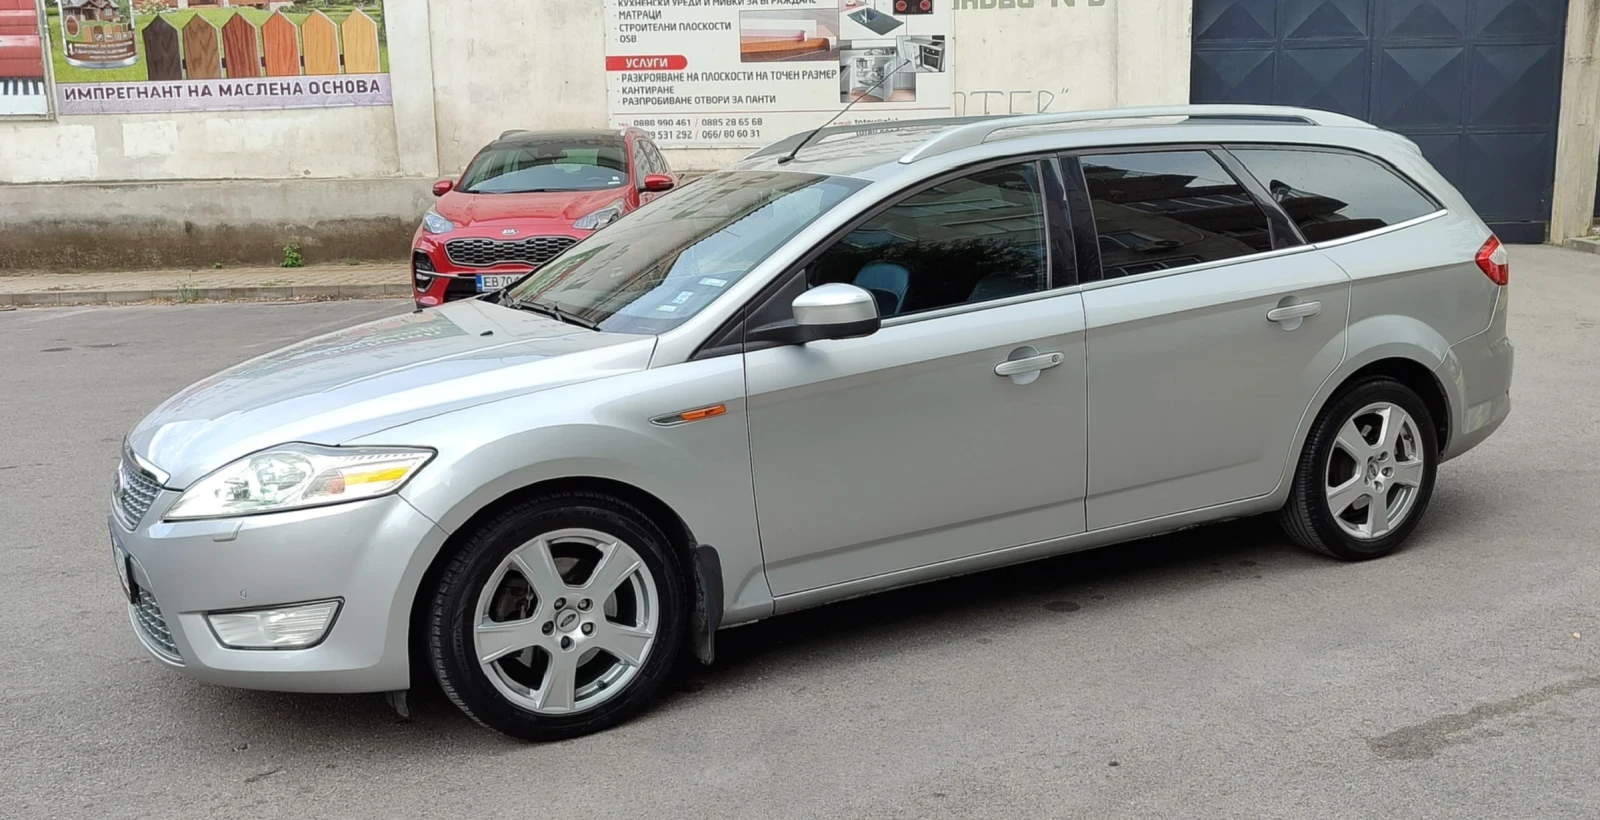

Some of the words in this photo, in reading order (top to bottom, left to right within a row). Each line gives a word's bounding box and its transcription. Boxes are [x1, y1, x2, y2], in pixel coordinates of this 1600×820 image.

[618, 10, 662, 20] МАТРАЦИ
[619, 23, 677, 32] СТРОИТЕЛНИ
[678, 22, 732, 31] ПЛОСКОСТИ
[619, 35, 637, 43] OSB
[625, 58, 668, 68] УСЛУГИ
[621, 72, 685, 83] РАЗКРОЯВАНЕ
[686, 72, 699, 81] НА
[701, 71, 754, 82] ПЛОСКОСТИ
[755, 71, 768, 80] НА
[770, 70, 800, 81] ТОЧЕН
[801, 70, 837, 80] РАЗМЕР
[64, 85, 183, 101] ИМПРЕГНАНТ
[188, 84, 213, 97] НА
[218, 82, 304, 97] МАСЛЕНА
[308, 79, 381, 95] ОСНОВА
[621, 85, 675, 95] КАНТИРАНЕ
[622, 96, 692, 106] РАЗПРОБИВАНЕ
[694, 95, 730, 105] ОТВОРИ
[732, 95, 744, 104] ЗА
[746, 94, 776, 104] ПАНТИ
[633, 119, 656, 127] 0888
[657, 119, 674, 127] 990
[701, 118, 724, 127] 0885
[725, 118, 737, 126] 28
[738, 118, 750, 126] 65
[751, 117, 763, 126] 68
[658, 130, 673, 140] 531
[676, 130, 693, 140] 292
[723, 130, 735, 138] 80
[736, 129, 748, 138] 60
[750, 129, 761, 138] 31
